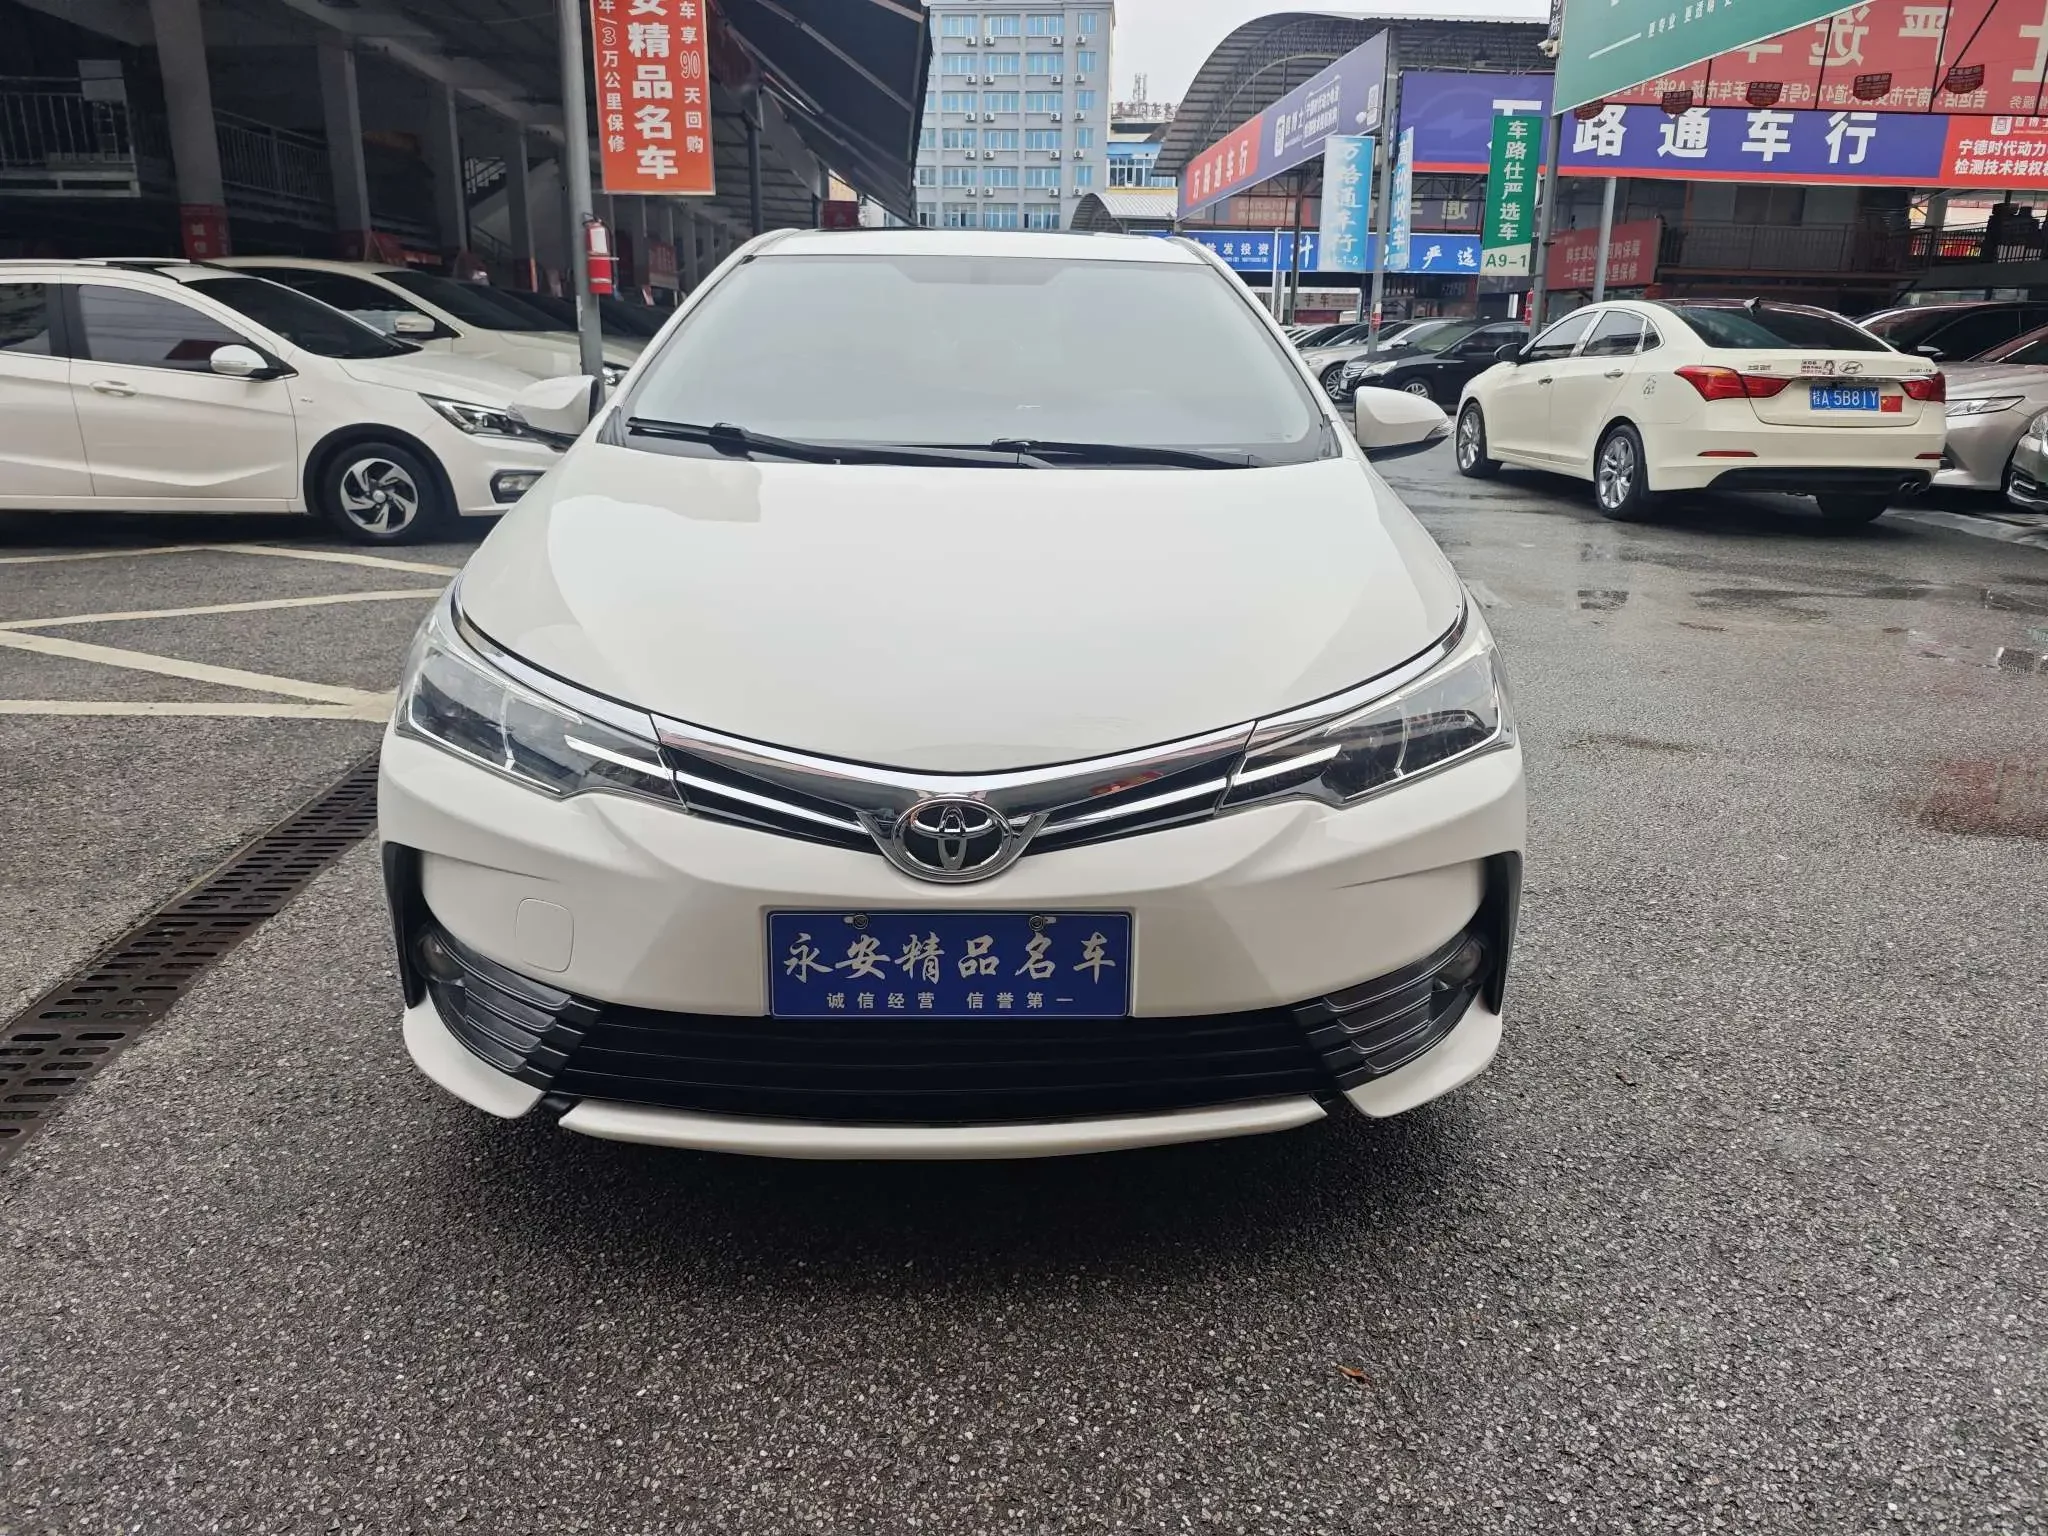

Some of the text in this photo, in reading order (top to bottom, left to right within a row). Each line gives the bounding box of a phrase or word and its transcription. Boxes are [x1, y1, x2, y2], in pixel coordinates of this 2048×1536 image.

[679, 1, 704, 153] 车享90天回购
[1497, 120, 1528, 241] 车路仕严选车
[1485, 253, 1527, 268] A9-1
[783, 932, 1116, 985] 永安精品名车
[826, 992, 1074, 1009] 诚信经营 信誉第一
